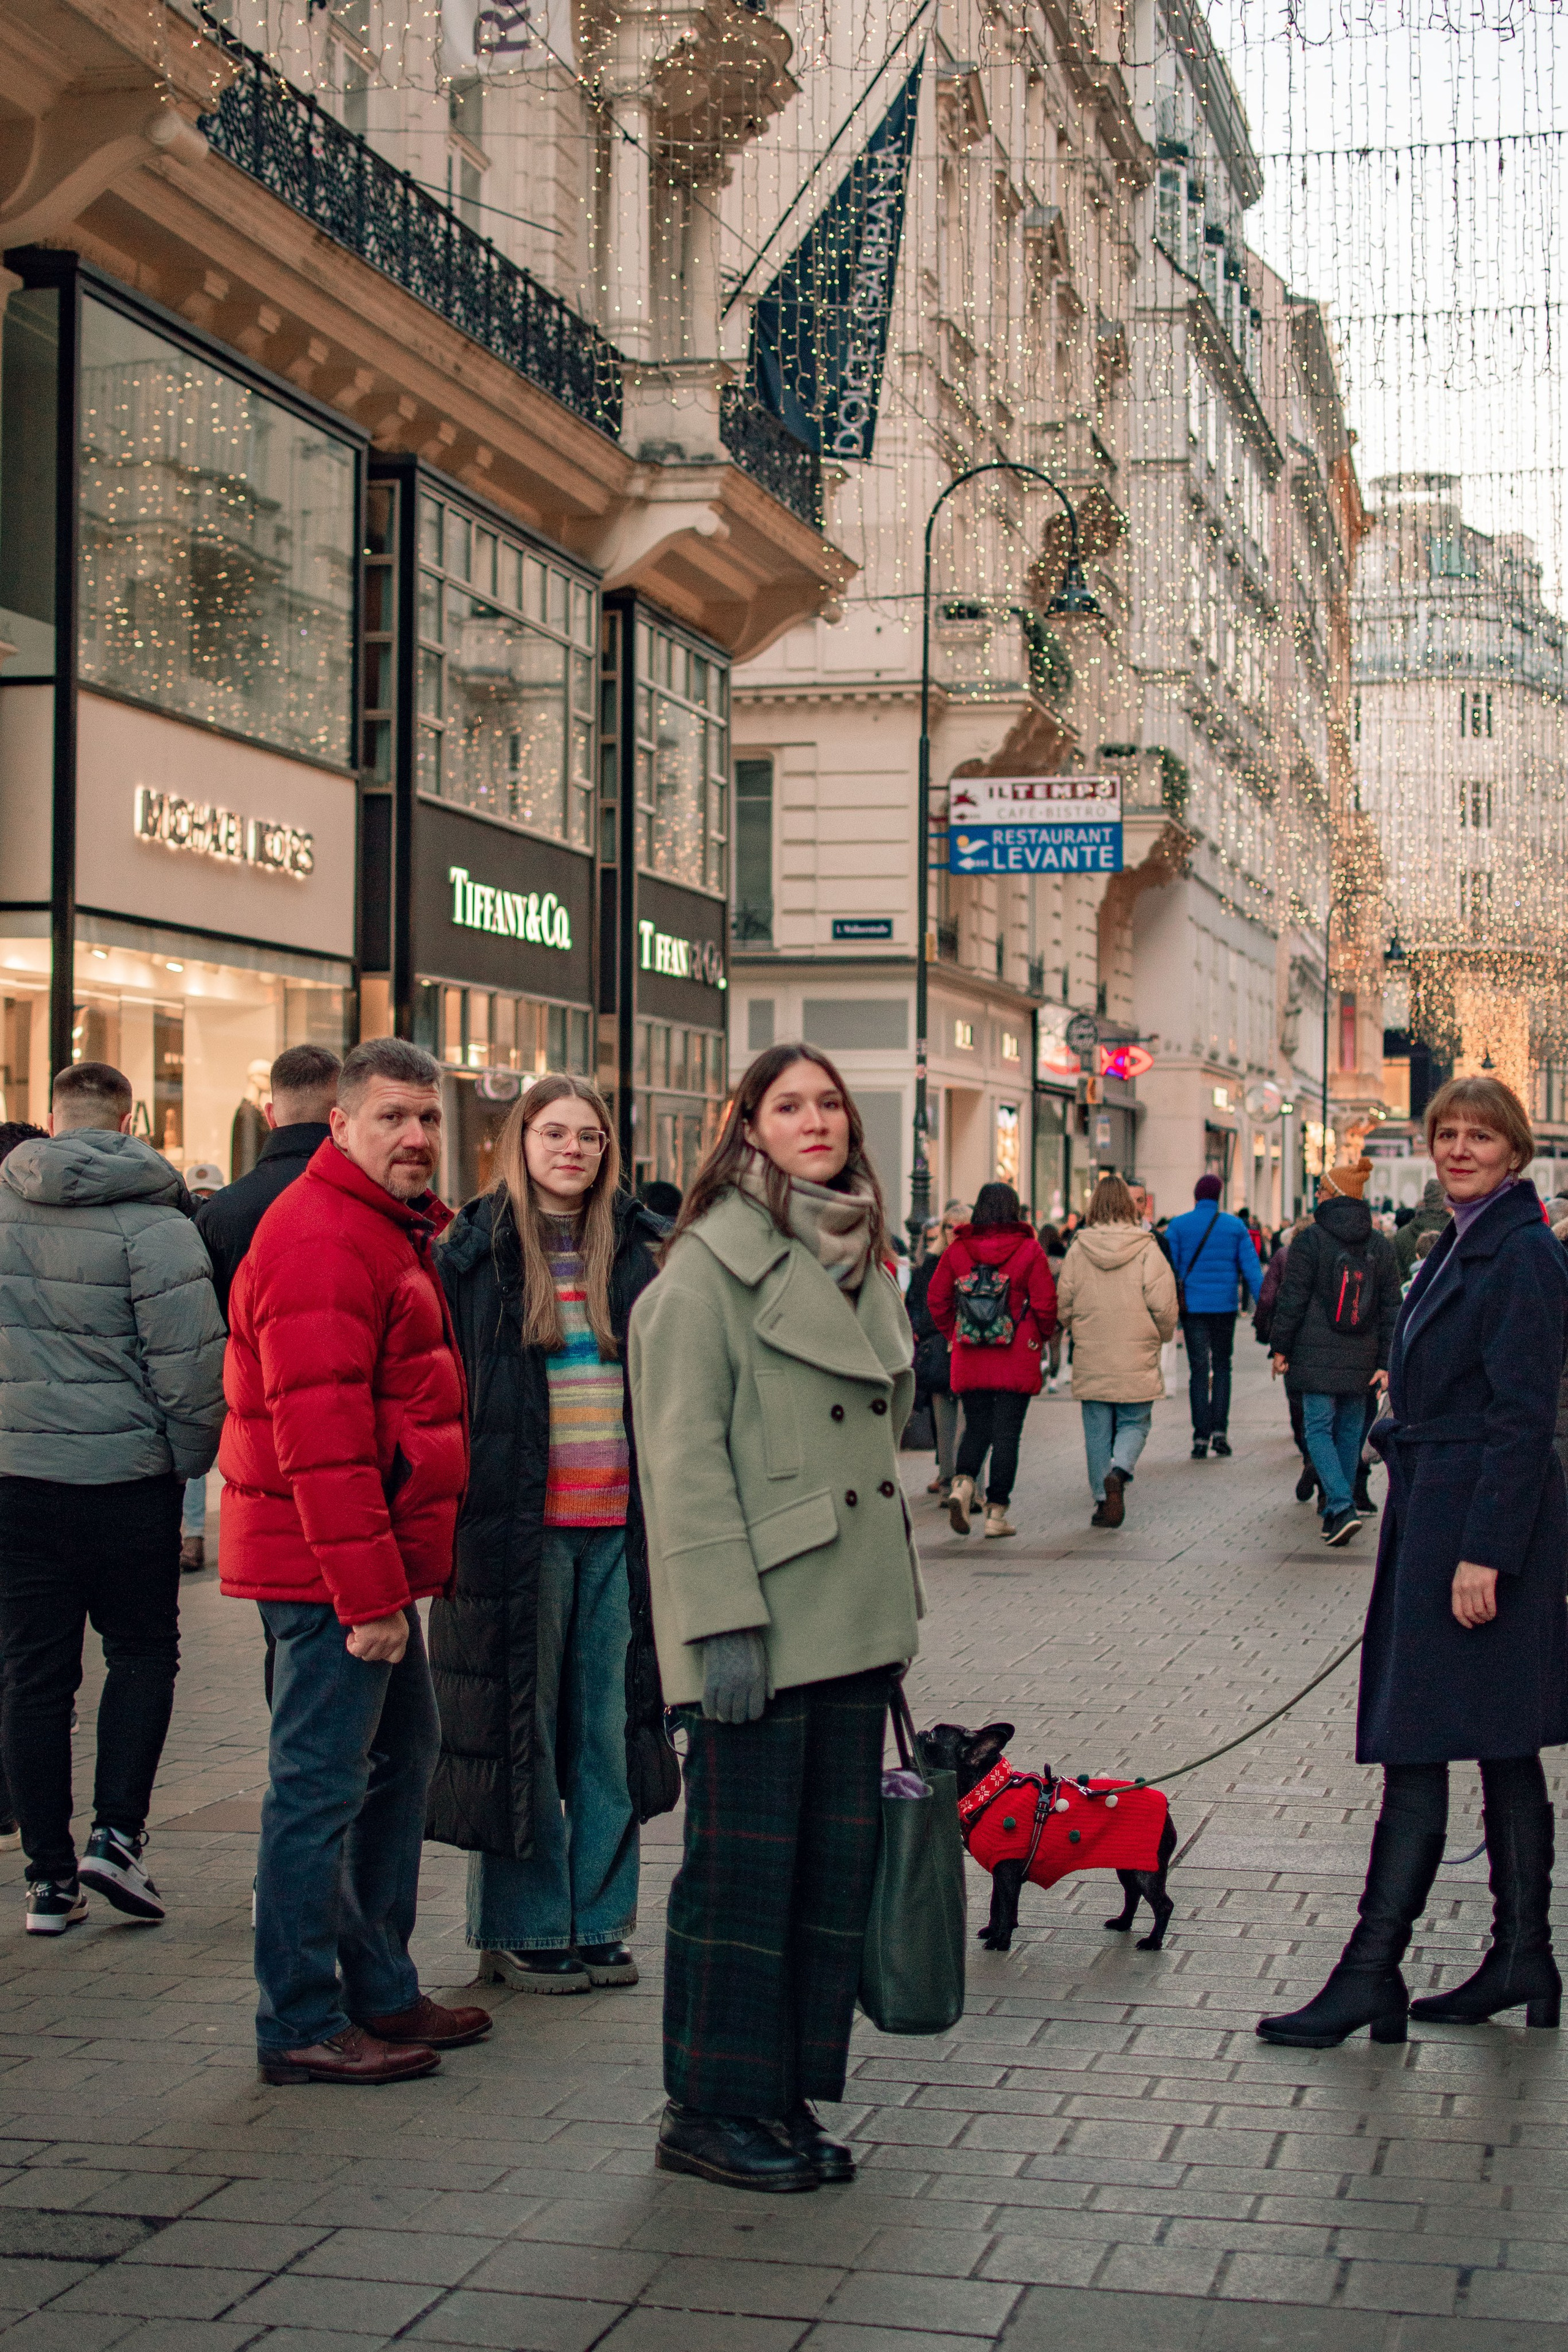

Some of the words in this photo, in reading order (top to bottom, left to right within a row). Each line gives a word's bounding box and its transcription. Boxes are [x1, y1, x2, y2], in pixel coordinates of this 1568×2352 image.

[854, 140, 903, 322] GABBANA
[833, 343, 876, 456] DOLCE
[1014, 782, 1112, 799] TEMPO
[134, 785, 246, 862] MICHAEL
[247, 817, 314, 881] KORS
[992, 828, 1114, 845] RESTAURANT
[992, 845, 1115, 869] LEVANTE
